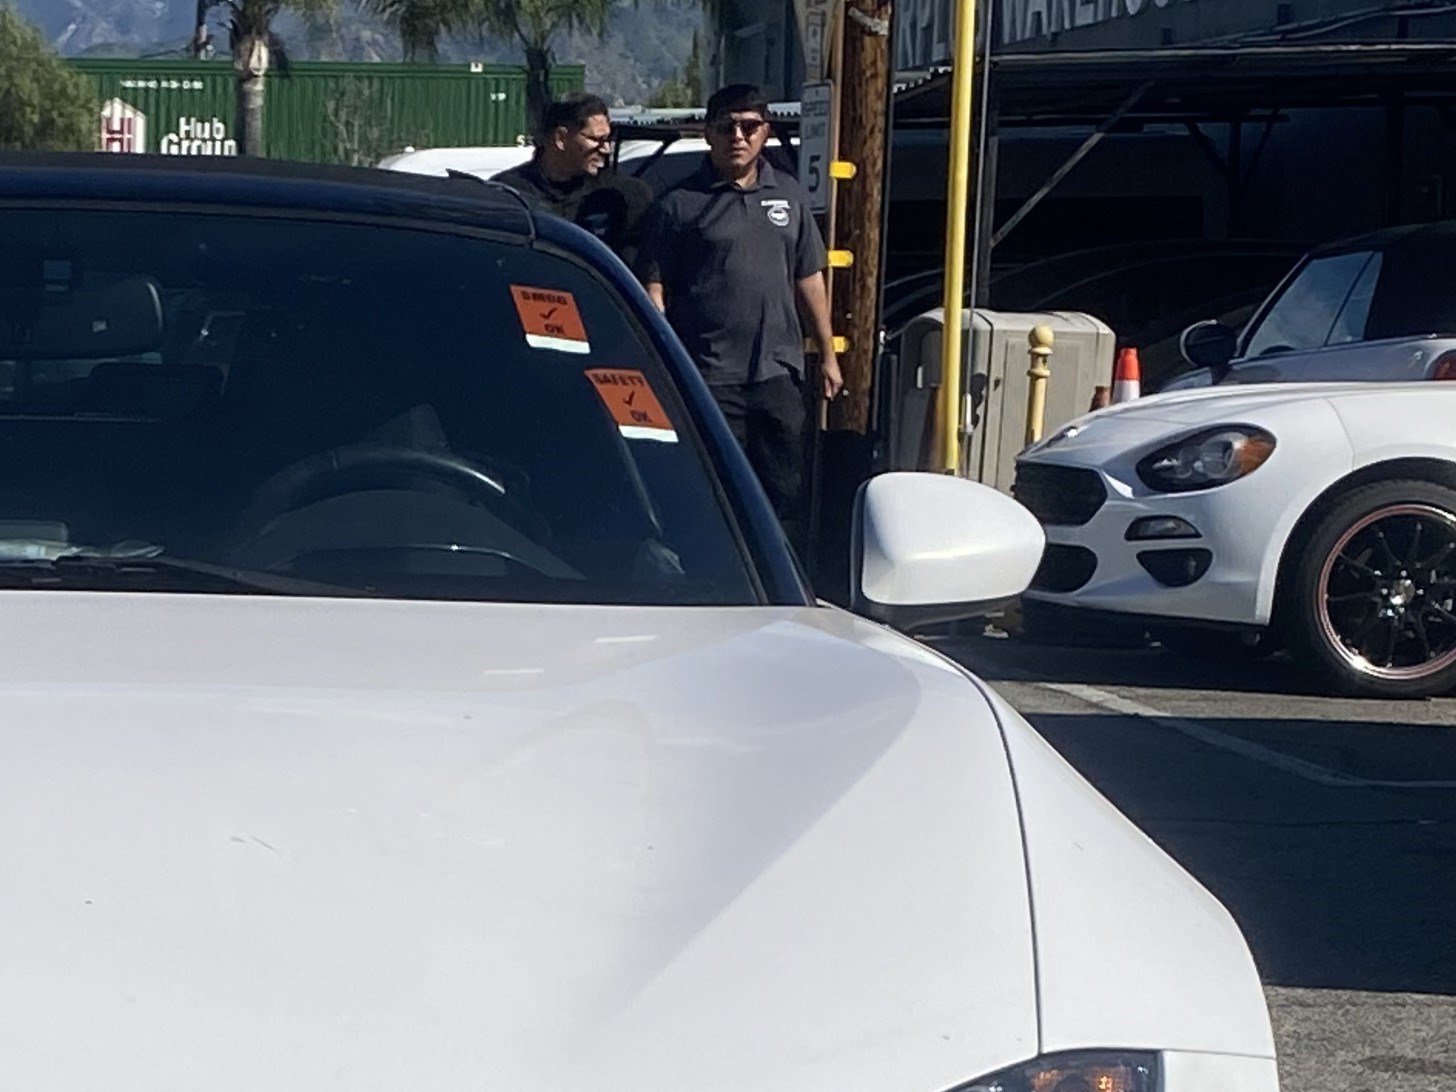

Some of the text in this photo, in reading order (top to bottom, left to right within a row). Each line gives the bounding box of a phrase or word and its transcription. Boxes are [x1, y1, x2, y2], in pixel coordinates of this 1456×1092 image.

[179, 117, 225, 139] Hub
[808, 155, 821, 193] 5
[593, 372, 644, 388] SAFETY
